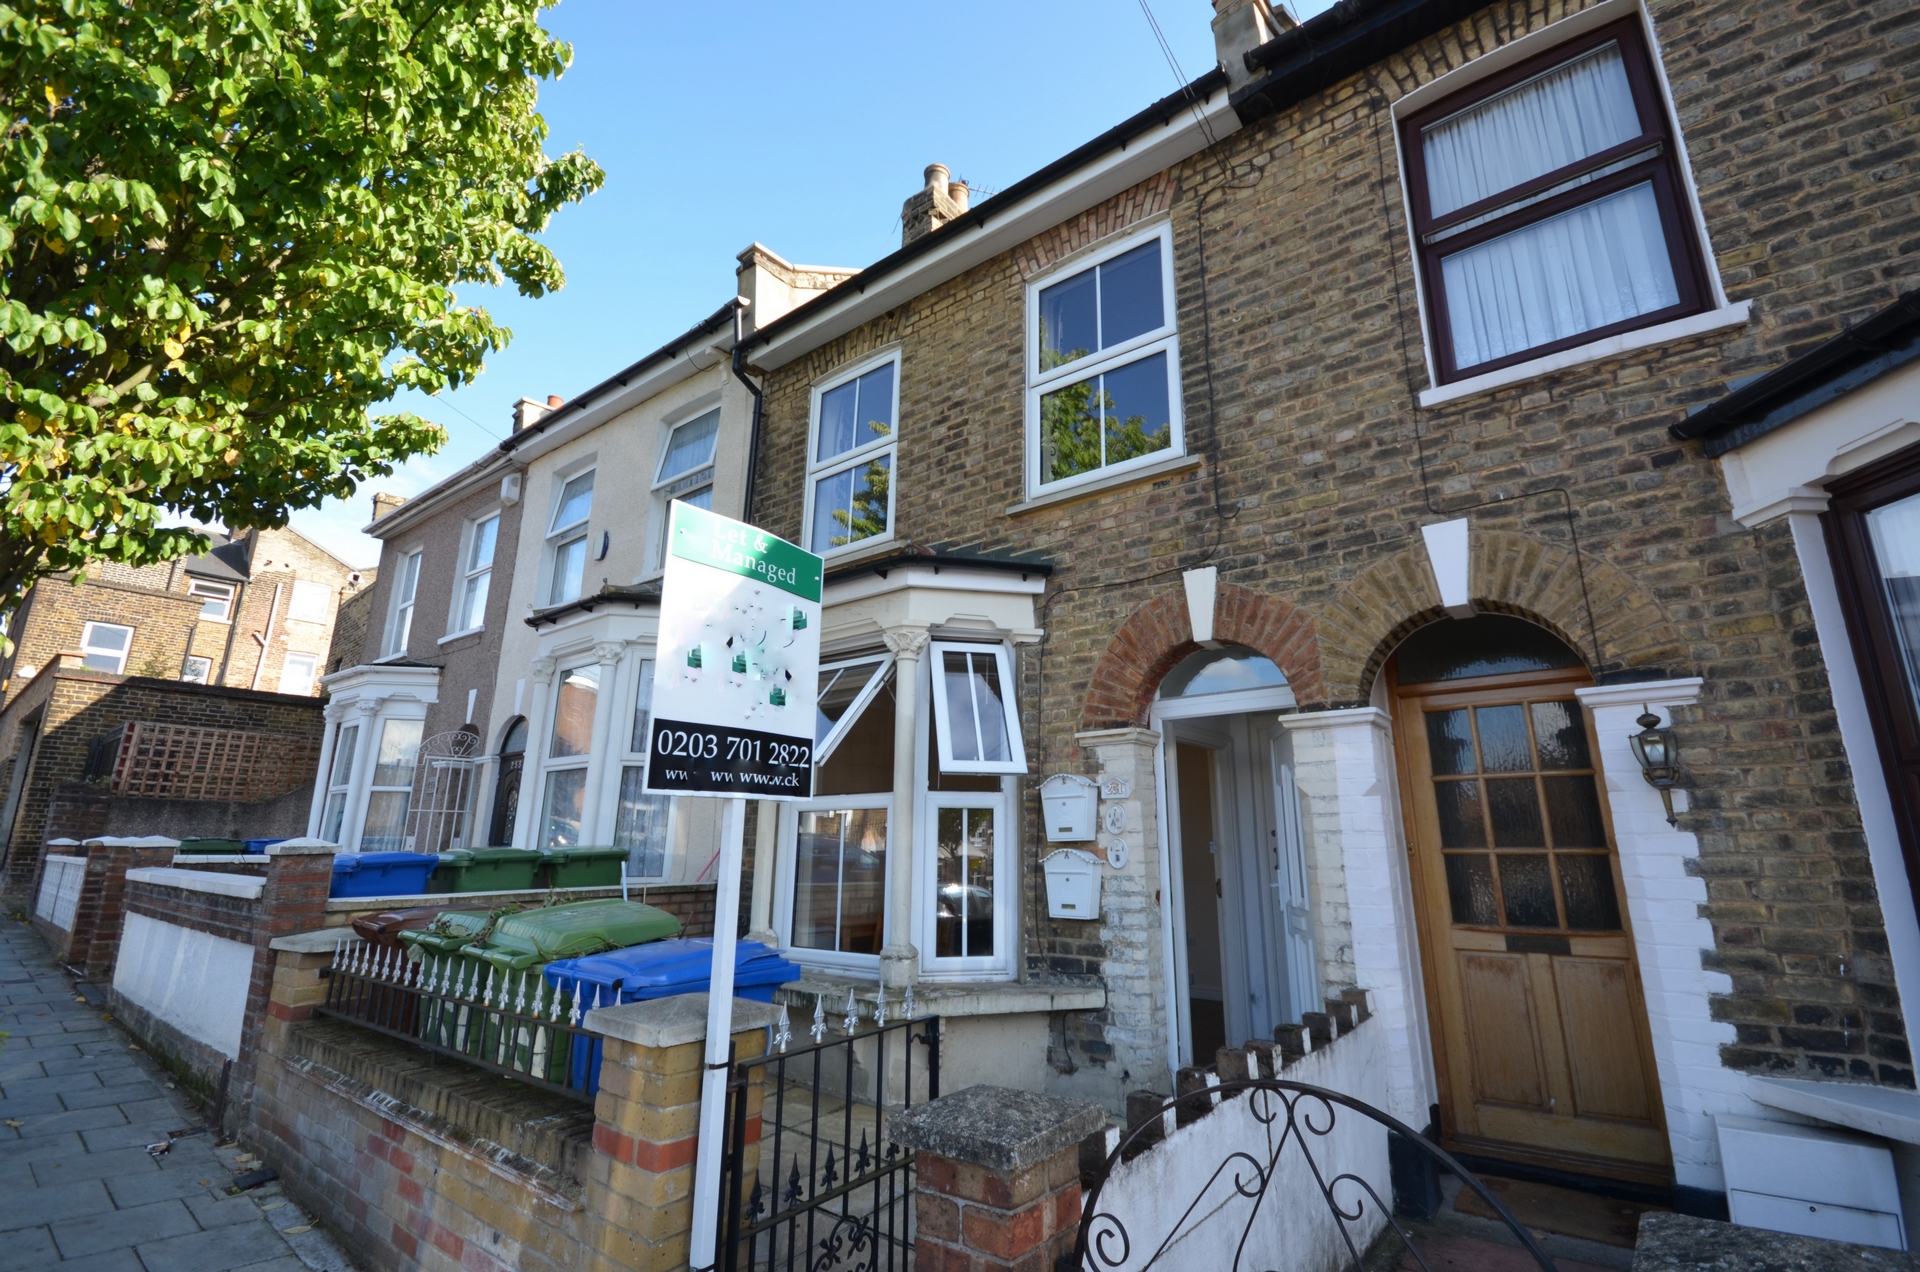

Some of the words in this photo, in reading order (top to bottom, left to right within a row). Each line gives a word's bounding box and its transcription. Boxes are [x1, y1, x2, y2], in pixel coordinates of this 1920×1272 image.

[713, 519, 747, 547] Let
[753, 533, 769, 554] &
[710, 538, 797, 586] Managed
[657, 729, 718, 759] 0203
[726, 736, 761, 762] 701
[768, 742, 810, 768] 2822
[1106, 784, 1123, 795] 251
